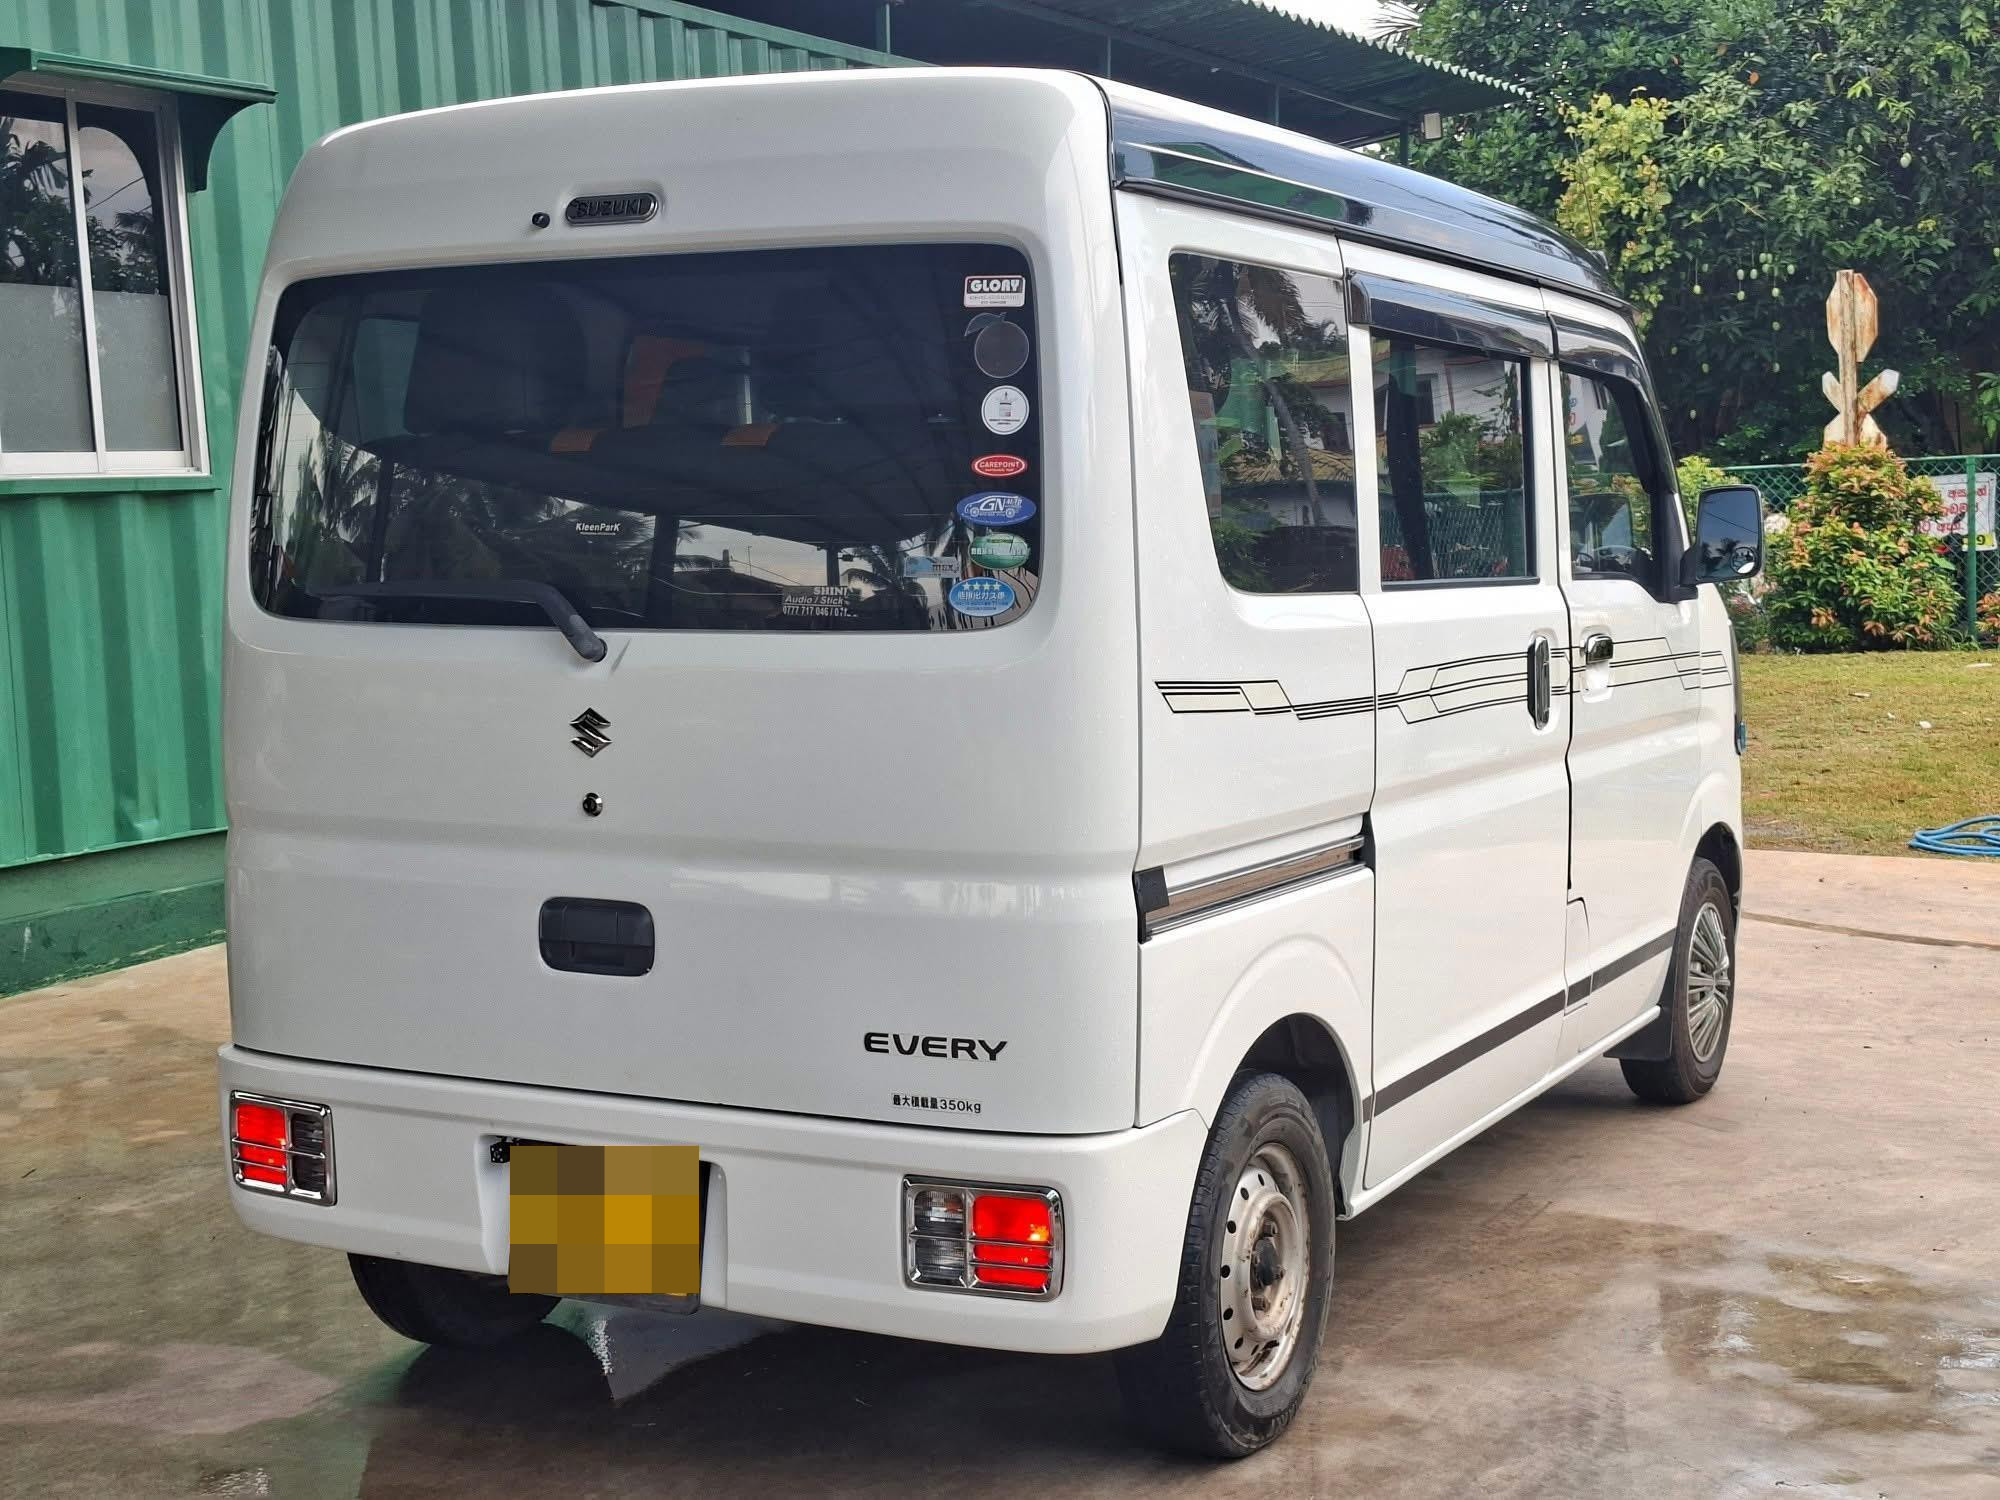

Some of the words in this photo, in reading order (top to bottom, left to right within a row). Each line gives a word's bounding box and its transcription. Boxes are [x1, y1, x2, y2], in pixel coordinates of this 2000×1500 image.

[575, 198, 642, 217] SUZUKI
[785, 595, 812, 604] Audio
[864, 1032, 1008, 1061] EVERY
